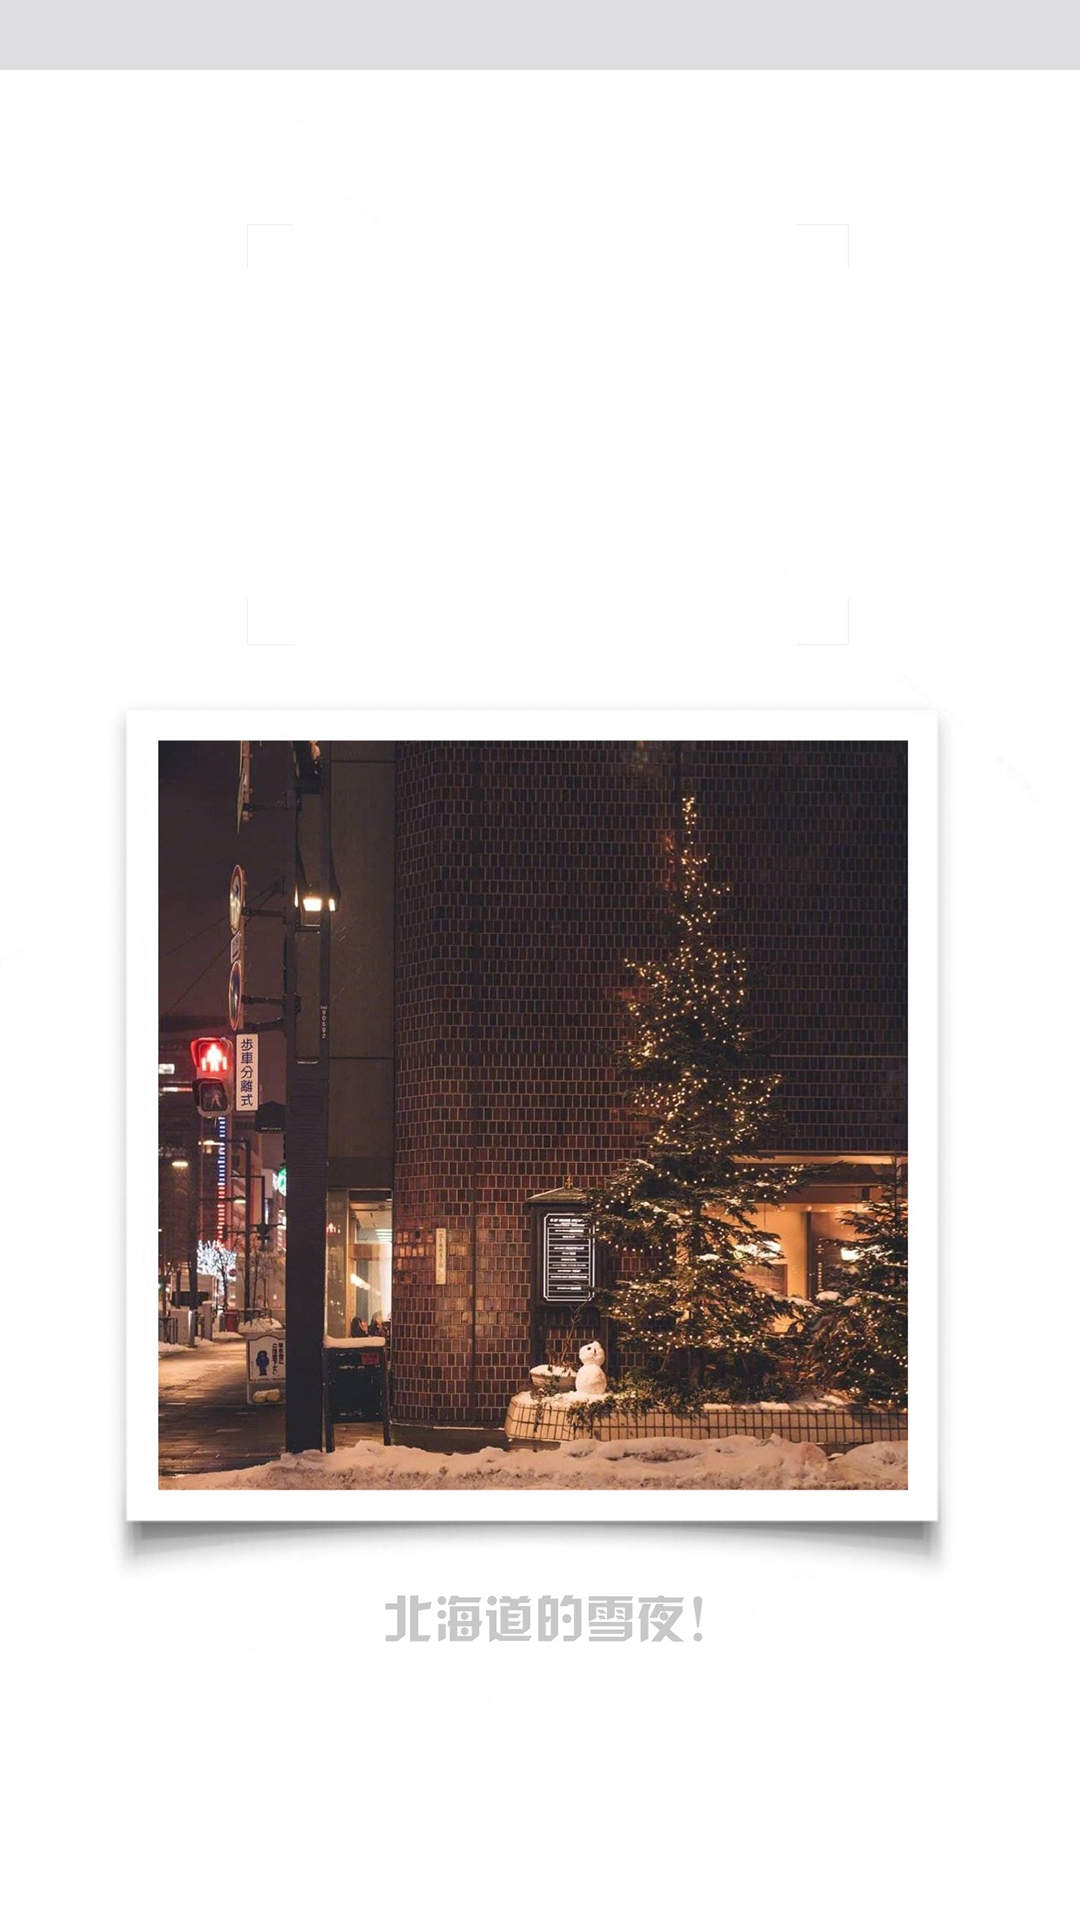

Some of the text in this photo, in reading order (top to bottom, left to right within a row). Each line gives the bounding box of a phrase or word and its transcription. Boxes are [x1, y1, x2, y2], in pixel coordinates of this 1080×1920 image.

[240, 1038, 254, 1107] 歩車分離式
